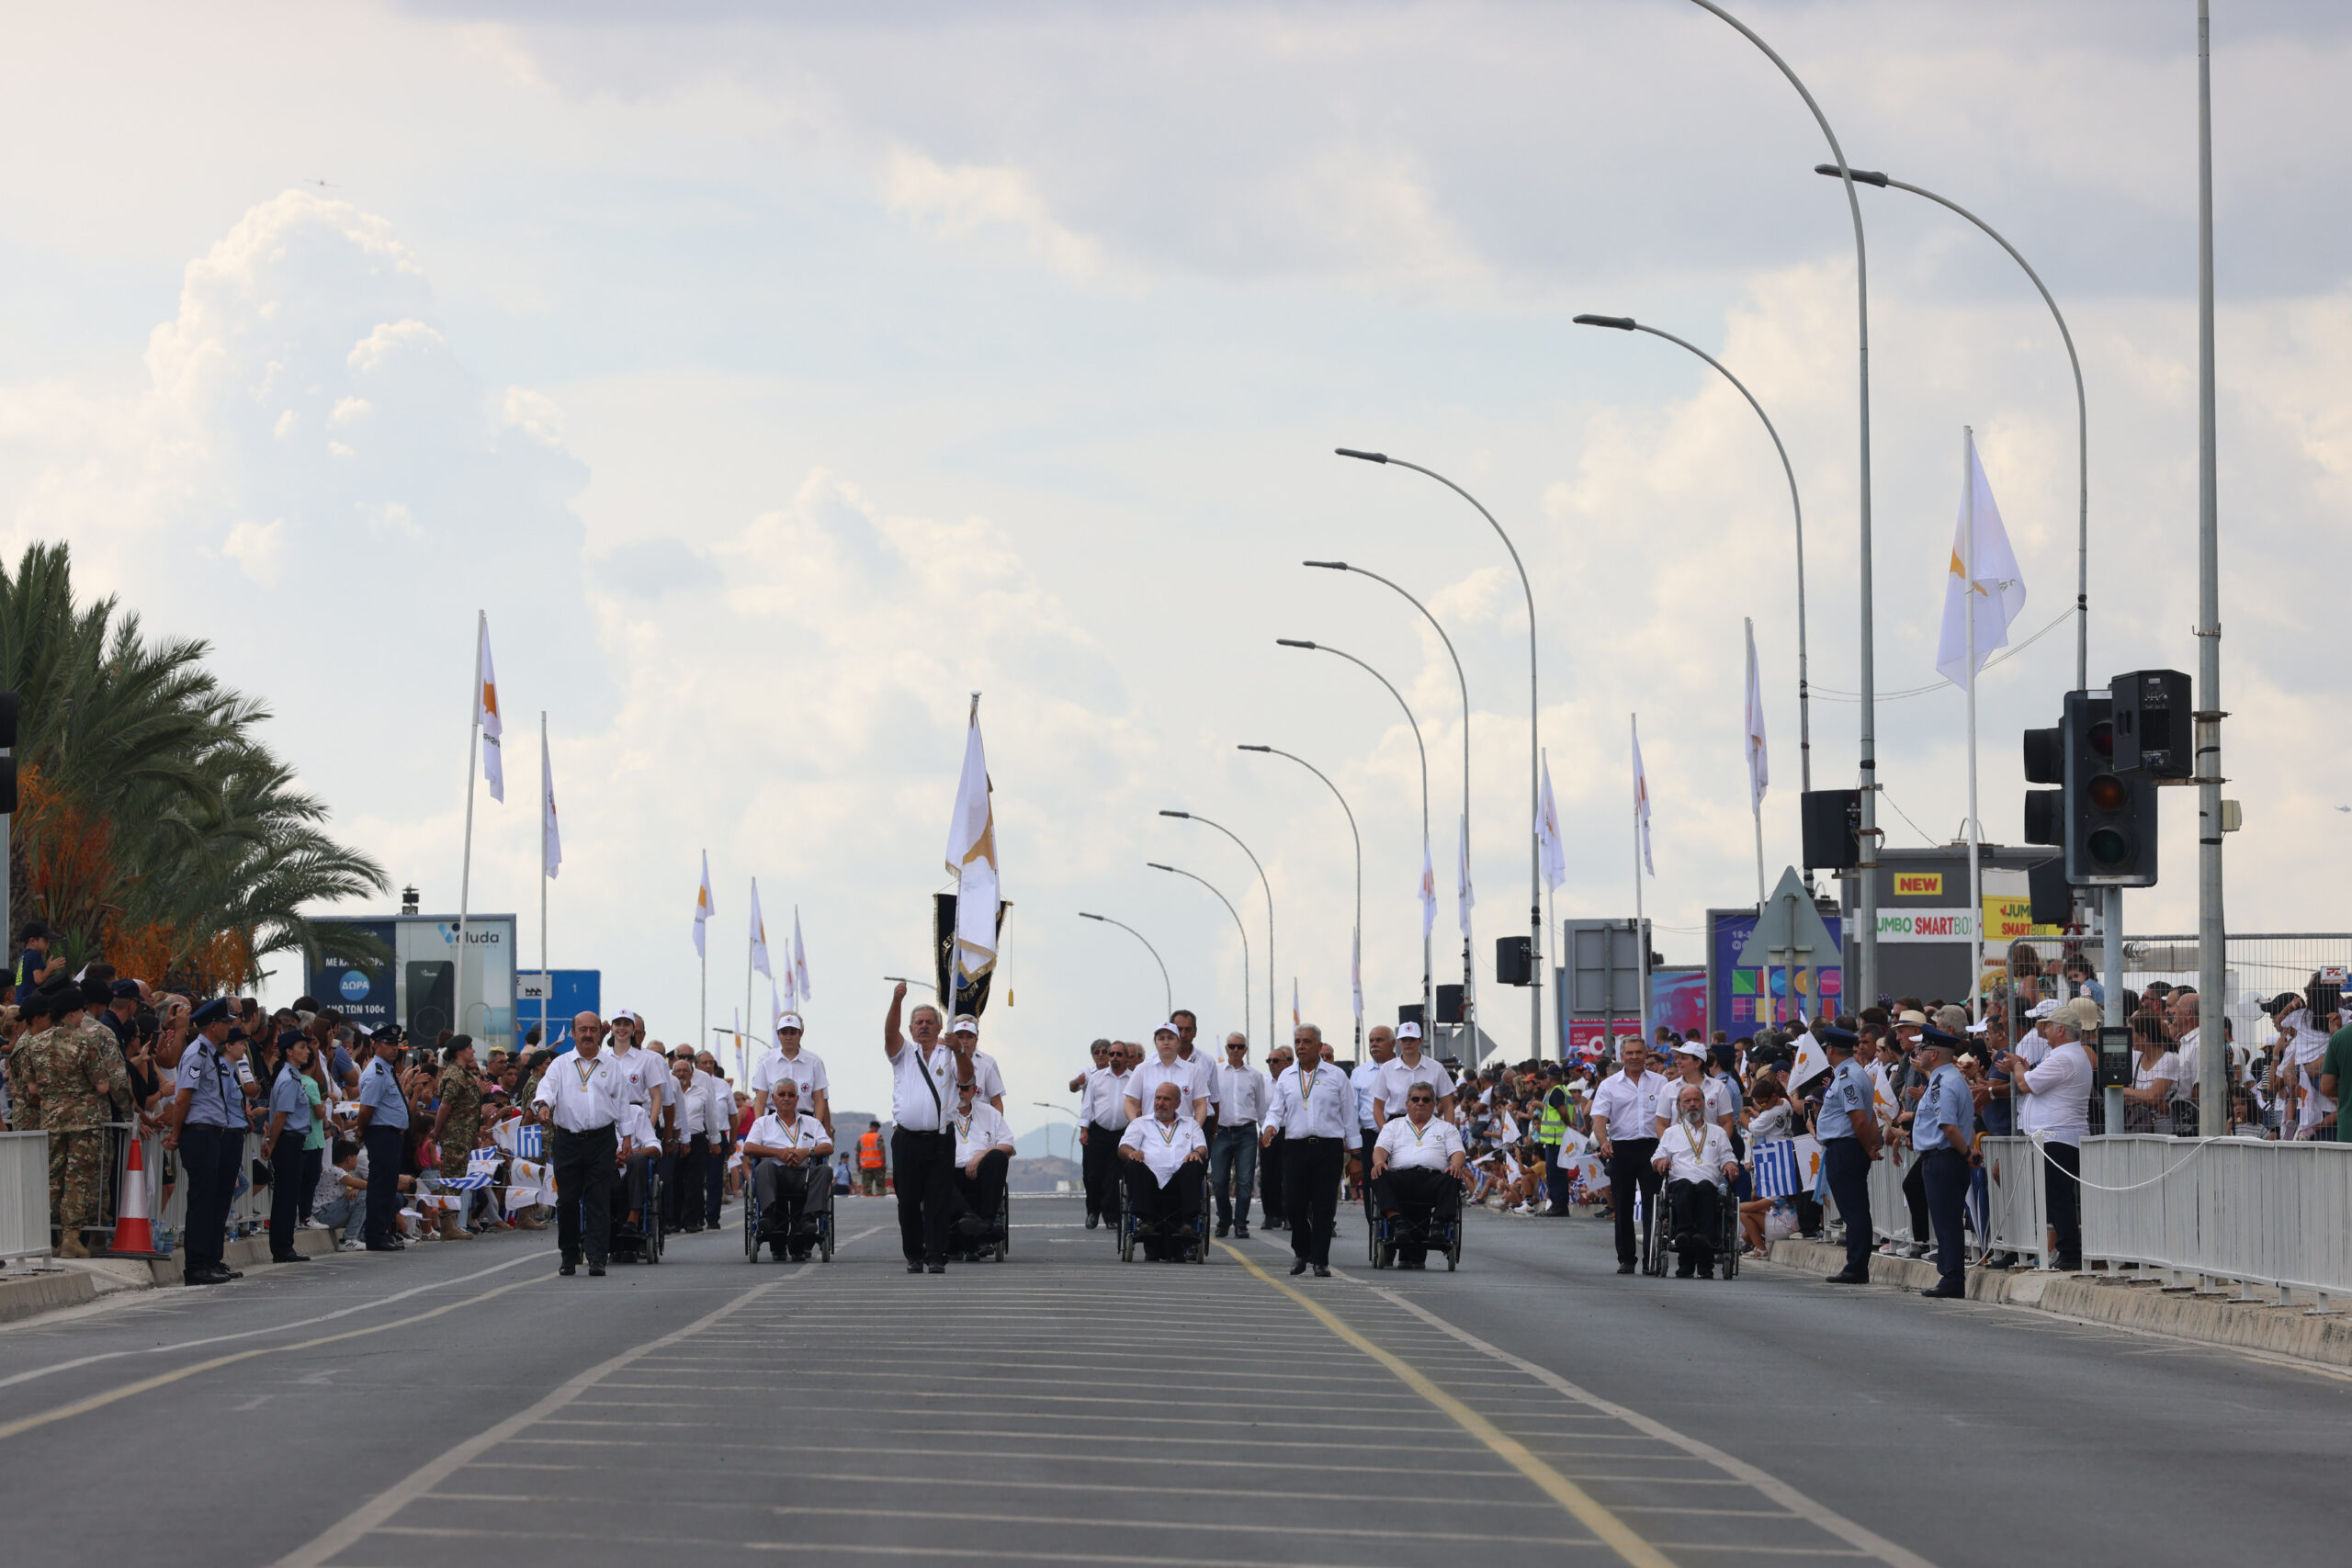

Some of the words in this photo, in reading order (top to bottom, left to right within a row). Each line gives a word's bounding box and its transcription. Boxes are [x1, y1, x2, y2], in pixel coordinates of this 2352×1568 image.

[1900, 877, 1938, 892] NEW
[2007, 904, 2031, 918] JUM
[1876, 917, 1912, 933] UMBO
[2001, 922, 2047, 936] SMARTBOX
[342, 981, 369, 990] ΔΩΡΑ
[345, 1004, 363, 1014] ΤΩΝ
[365, 1004, 386, 1014] 100€
